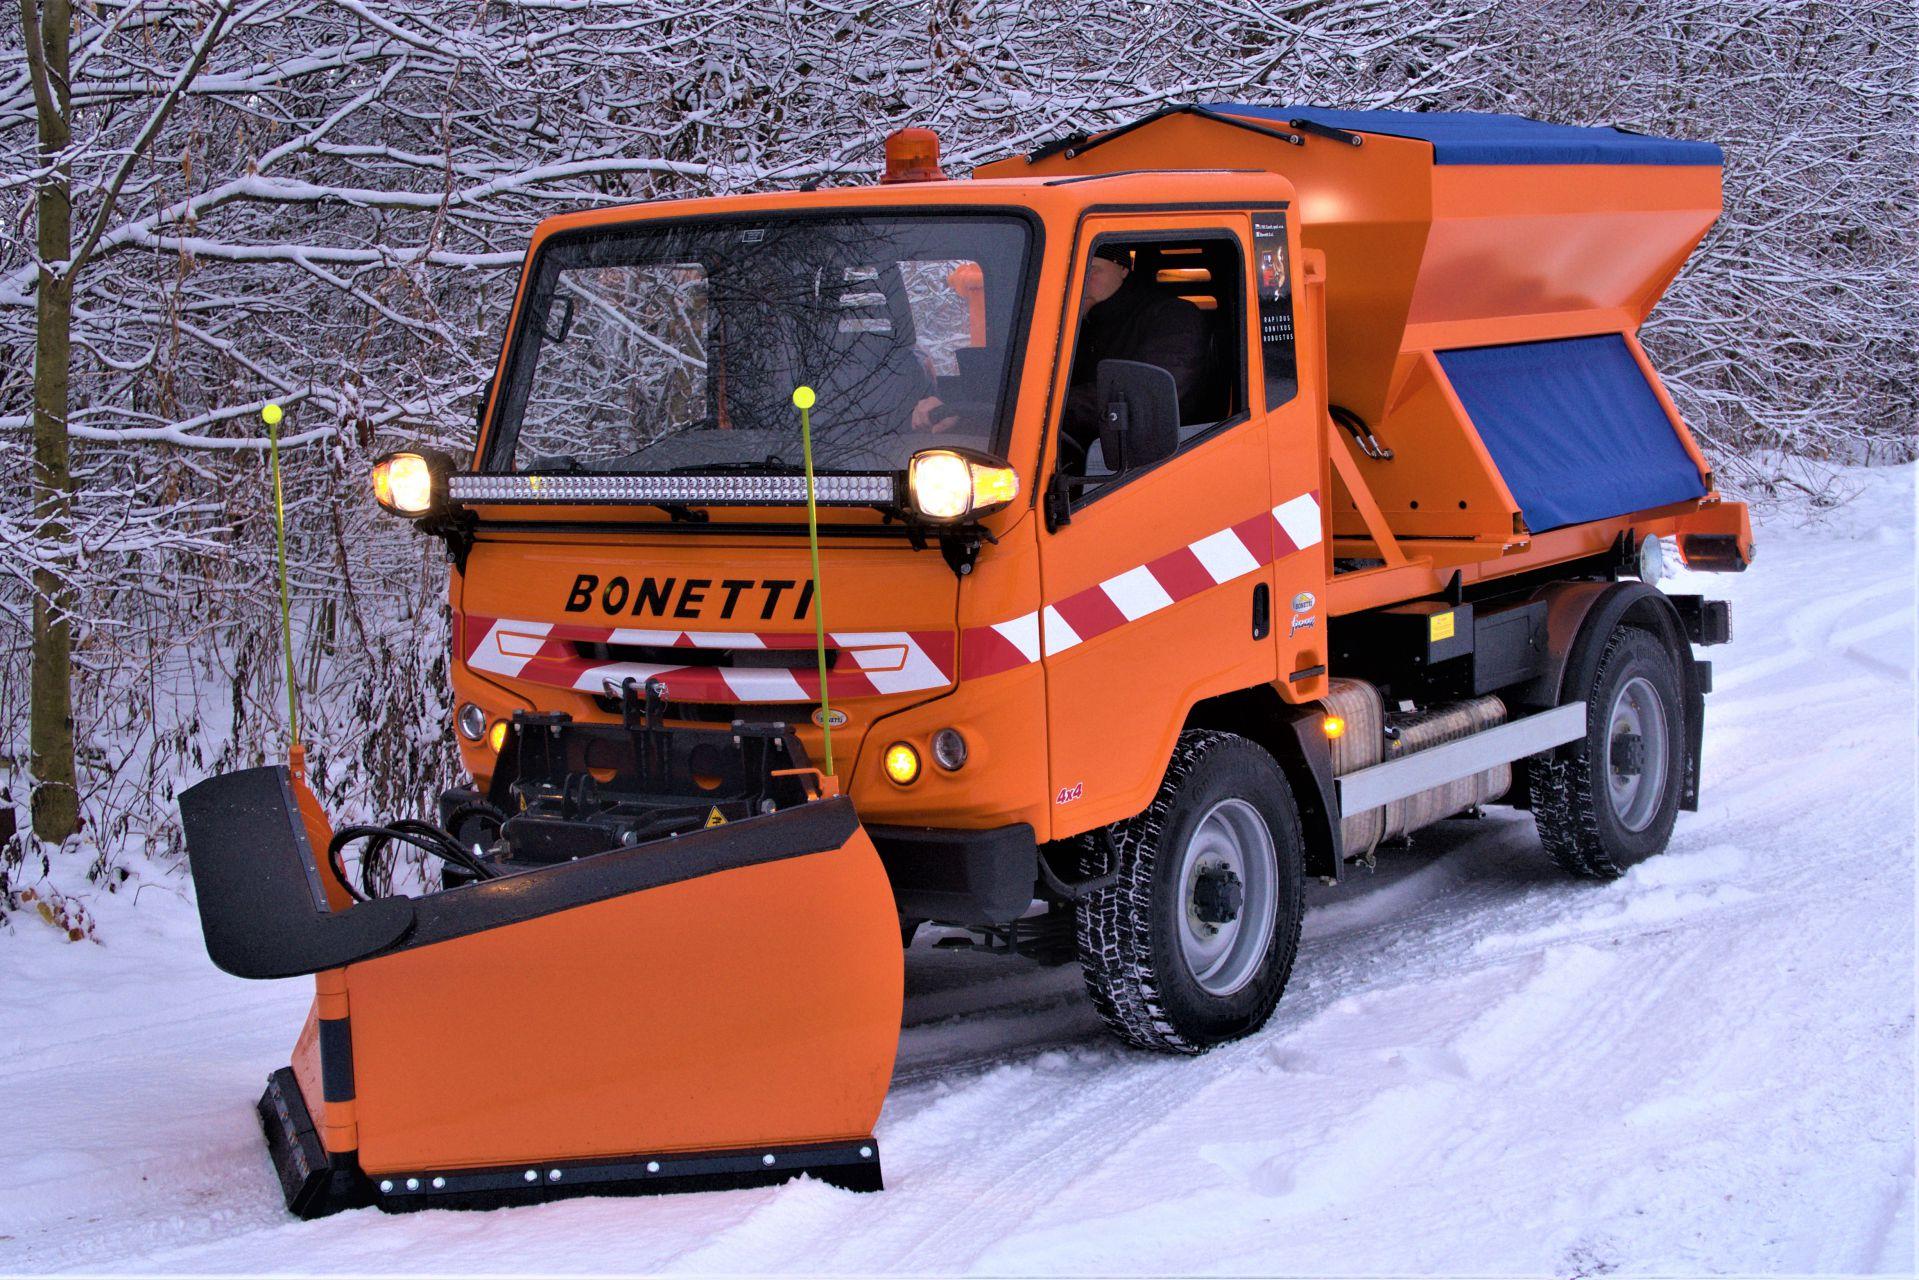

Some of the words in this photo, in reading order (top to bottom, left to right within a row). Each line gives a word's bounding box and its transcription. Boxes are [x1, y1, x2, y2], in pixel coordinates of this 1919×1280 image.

[1264, 315, 1290, 323] RAPIDUS
[1263, 334, 1294, 342] ROBUSTUS
[564, 574, 815, 620] BONETTI
[1056, 782, 1083, 804] 4x4
